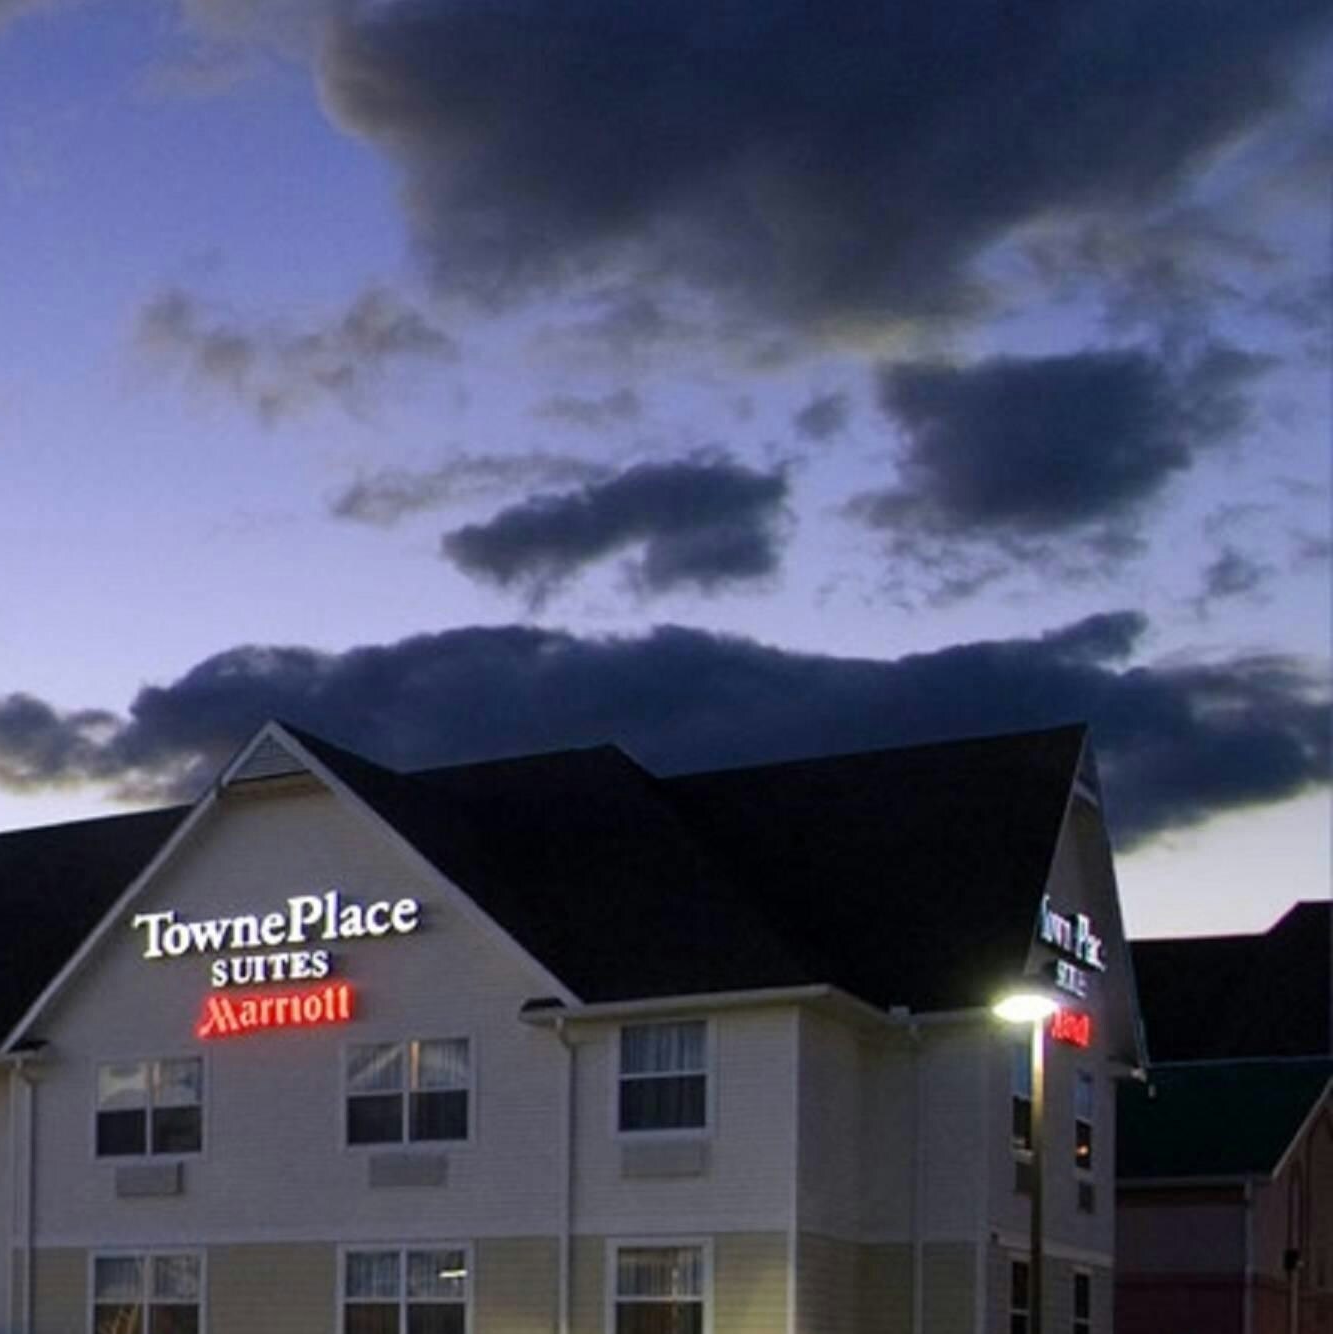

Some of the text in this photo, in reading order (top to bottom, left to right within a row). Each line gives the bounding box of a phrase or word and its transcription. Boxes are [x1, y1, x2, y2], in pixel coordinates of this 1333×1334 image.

[133, 889, 420, 959] TownePlace
[211, 950, 330, 987] SUITES
[196, 984, 353, 1038] Marriott
